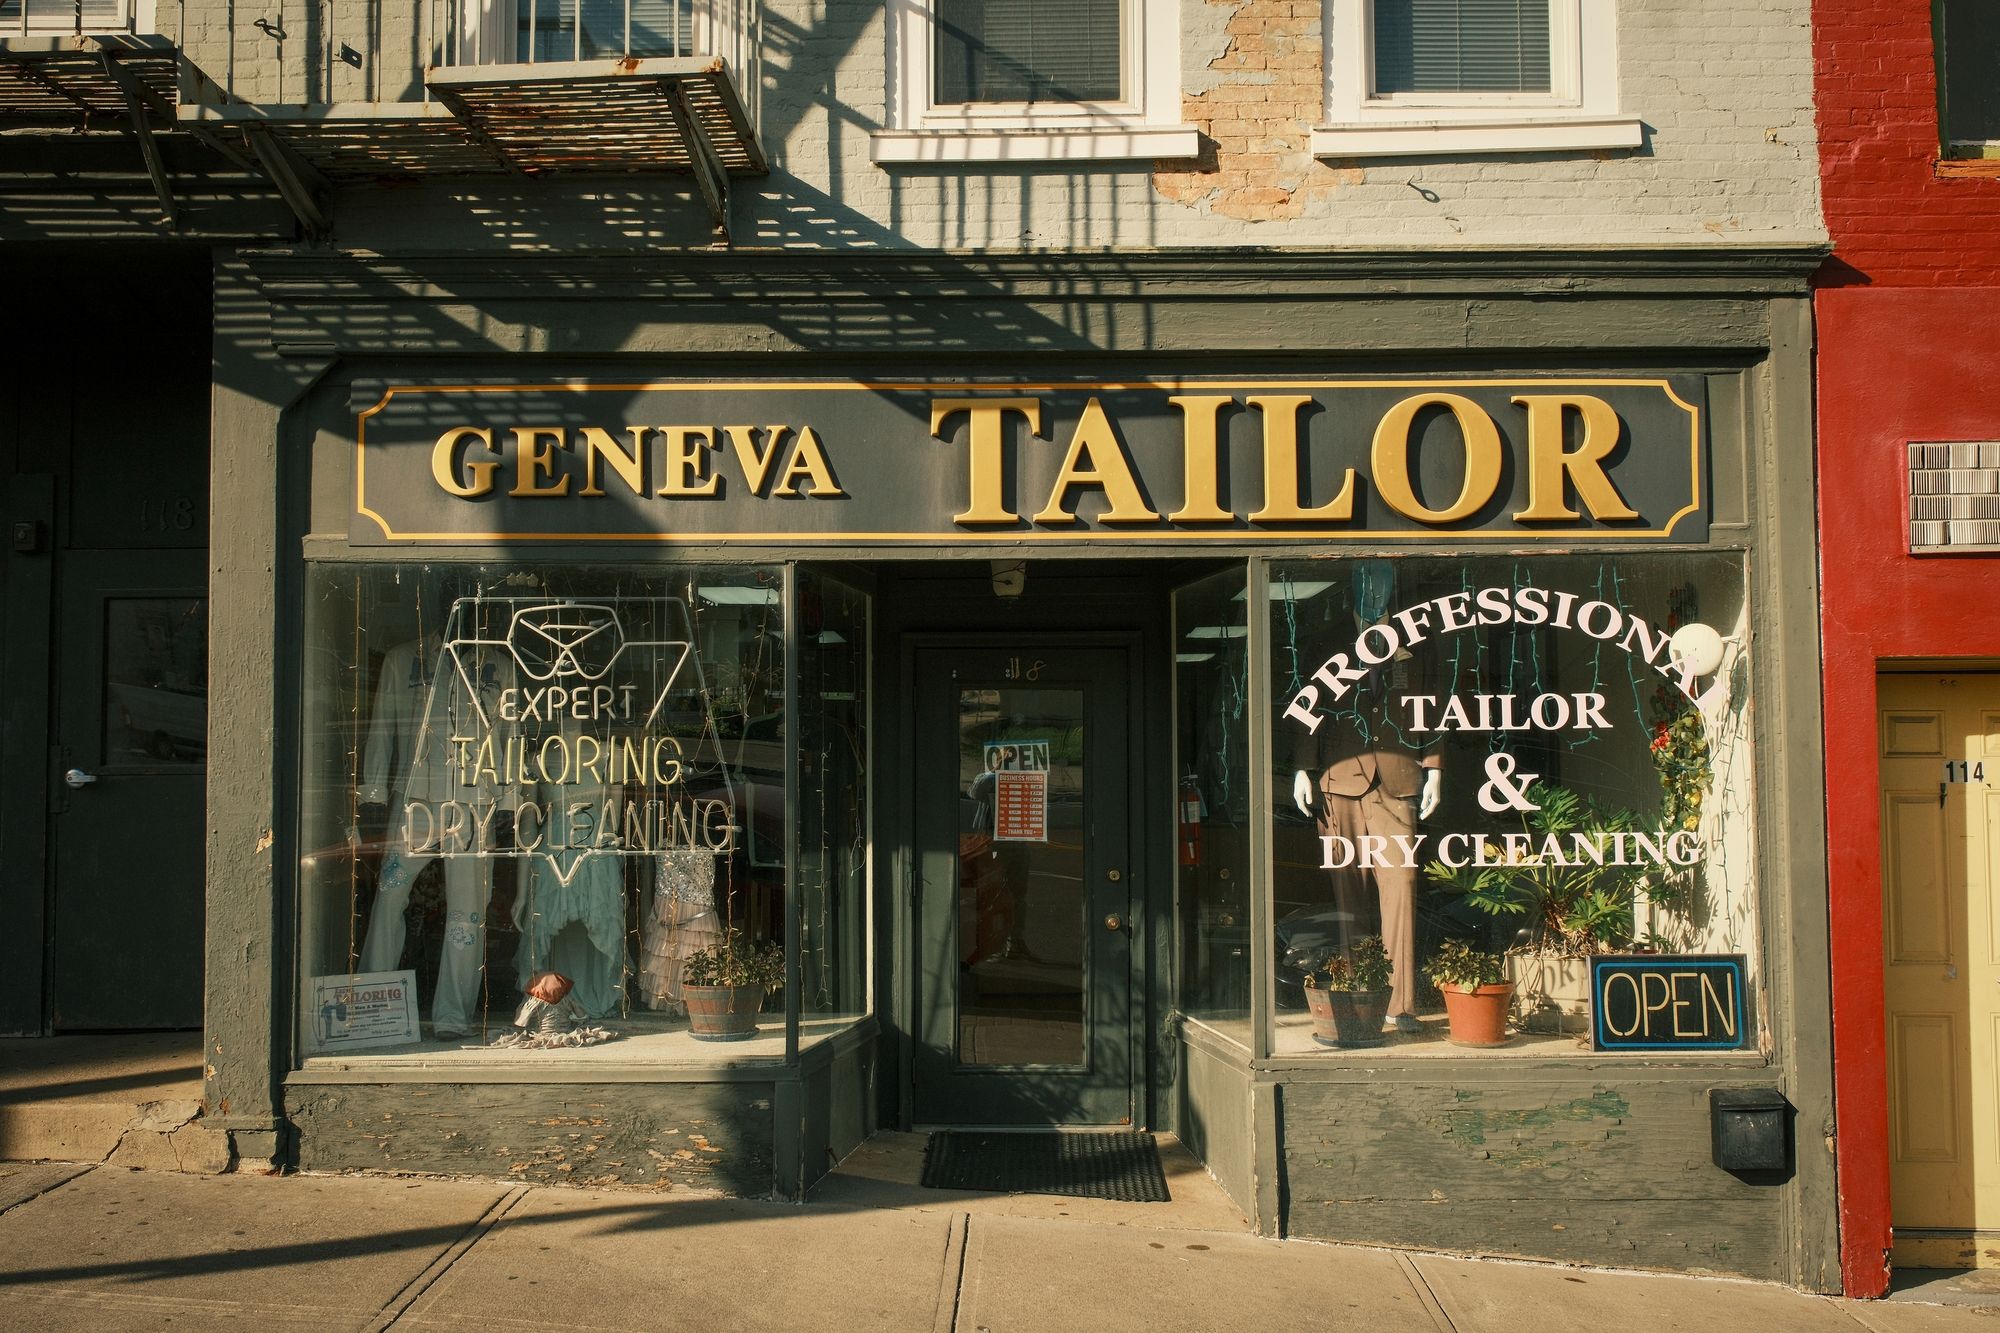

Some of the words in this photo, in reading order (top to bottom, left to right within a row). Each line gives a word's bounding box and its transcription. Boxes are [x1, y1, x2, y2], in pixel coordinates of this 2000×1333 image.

[431, 425, 843, 498] GENEVA
[930, 392, 1640, 524] TAILOR
[141, 496, 195, 531] 118
[1282, 587, 1730, 735] PROFESSIONAL
[500, 685, 638, 722] EXPERT
[1401, 692, 1613, 732] TAILOR
[452, 735, 684, 787] TAILORING
[986, 743, 1048, 771] OPEN
[1945, 761, 1984, 783] 114
[1477, 752, 1542, 813] &
[402, 799, 498, 854] DRY
[514, 799, 742, 852] CLEANING
[1319, 833, 1427, 869] DRY
[1438, 831, 1702, 869] CLEANING
[1603, 972, 1735, 1038] OPEN
